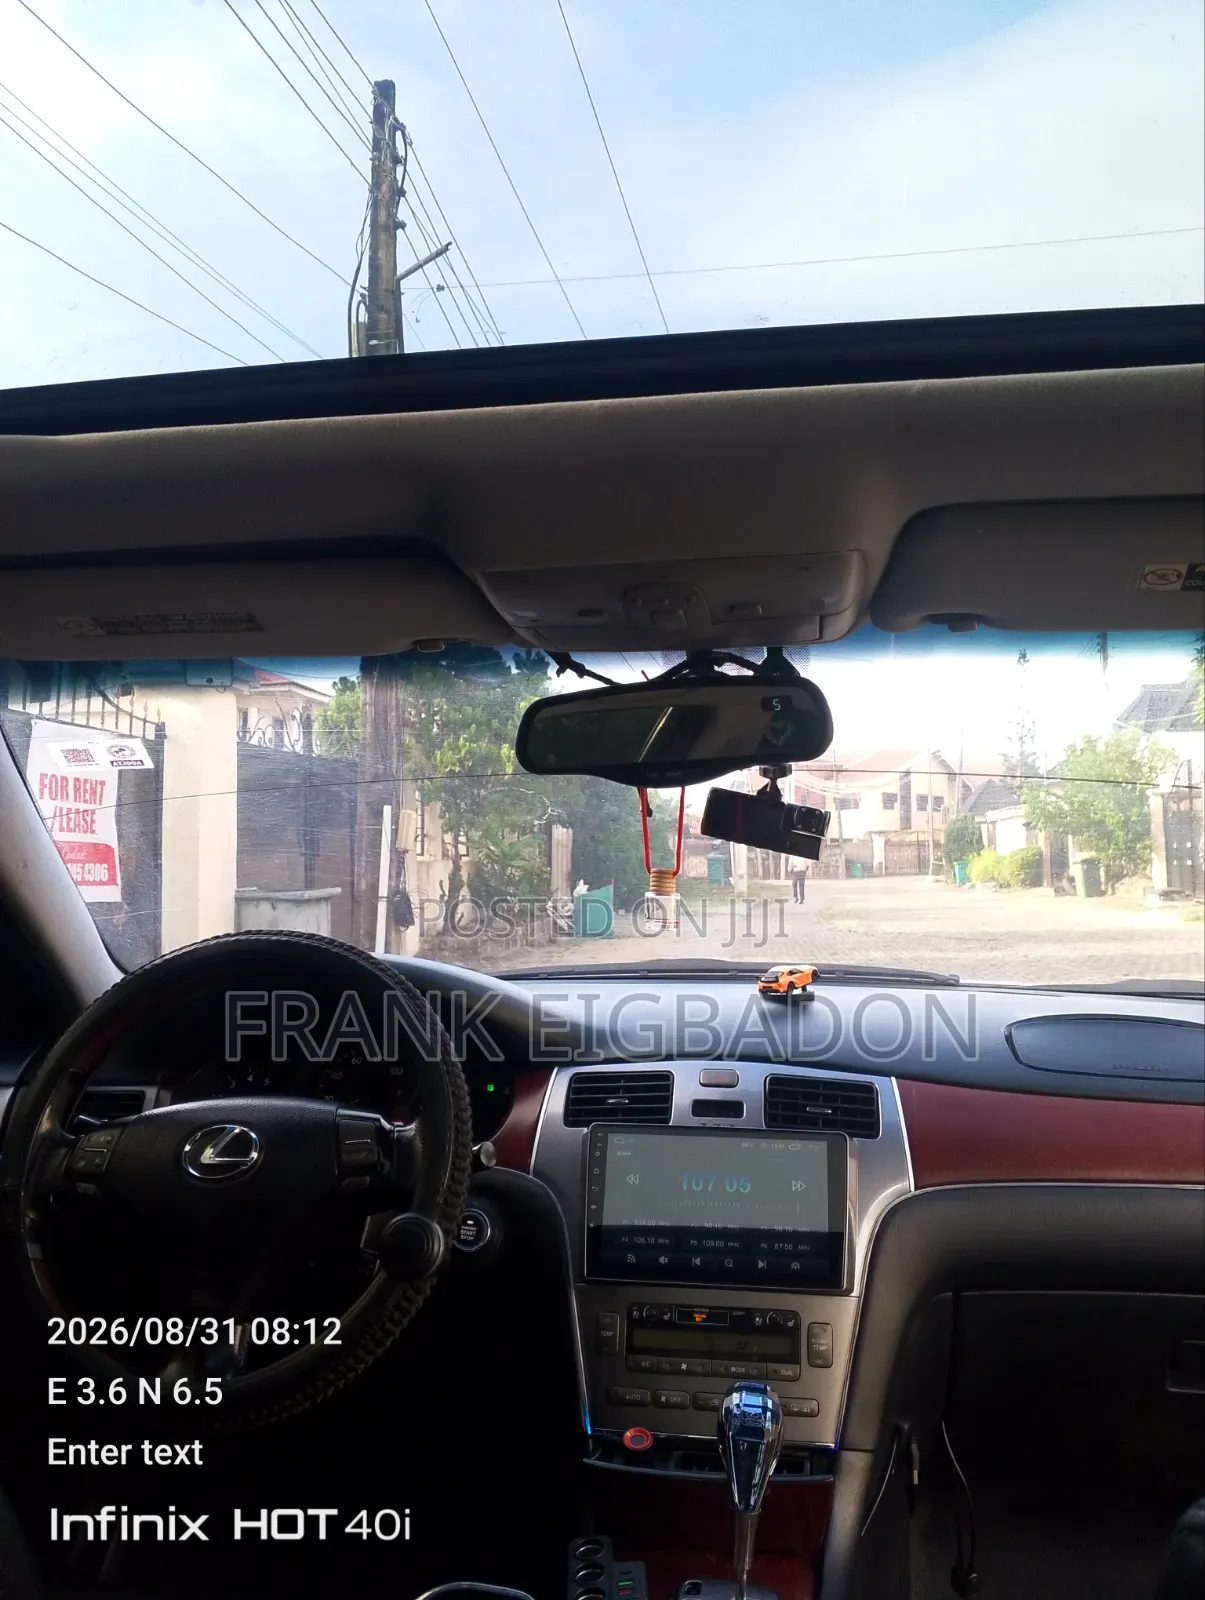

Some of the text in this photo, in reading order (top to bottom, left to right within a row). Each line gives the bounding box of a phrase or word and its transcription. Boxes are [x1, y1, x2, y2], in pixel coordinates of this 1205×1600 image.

[38, 772, 107, 806] FOR RENT
[49, 806, 97, 835] /LEASE
